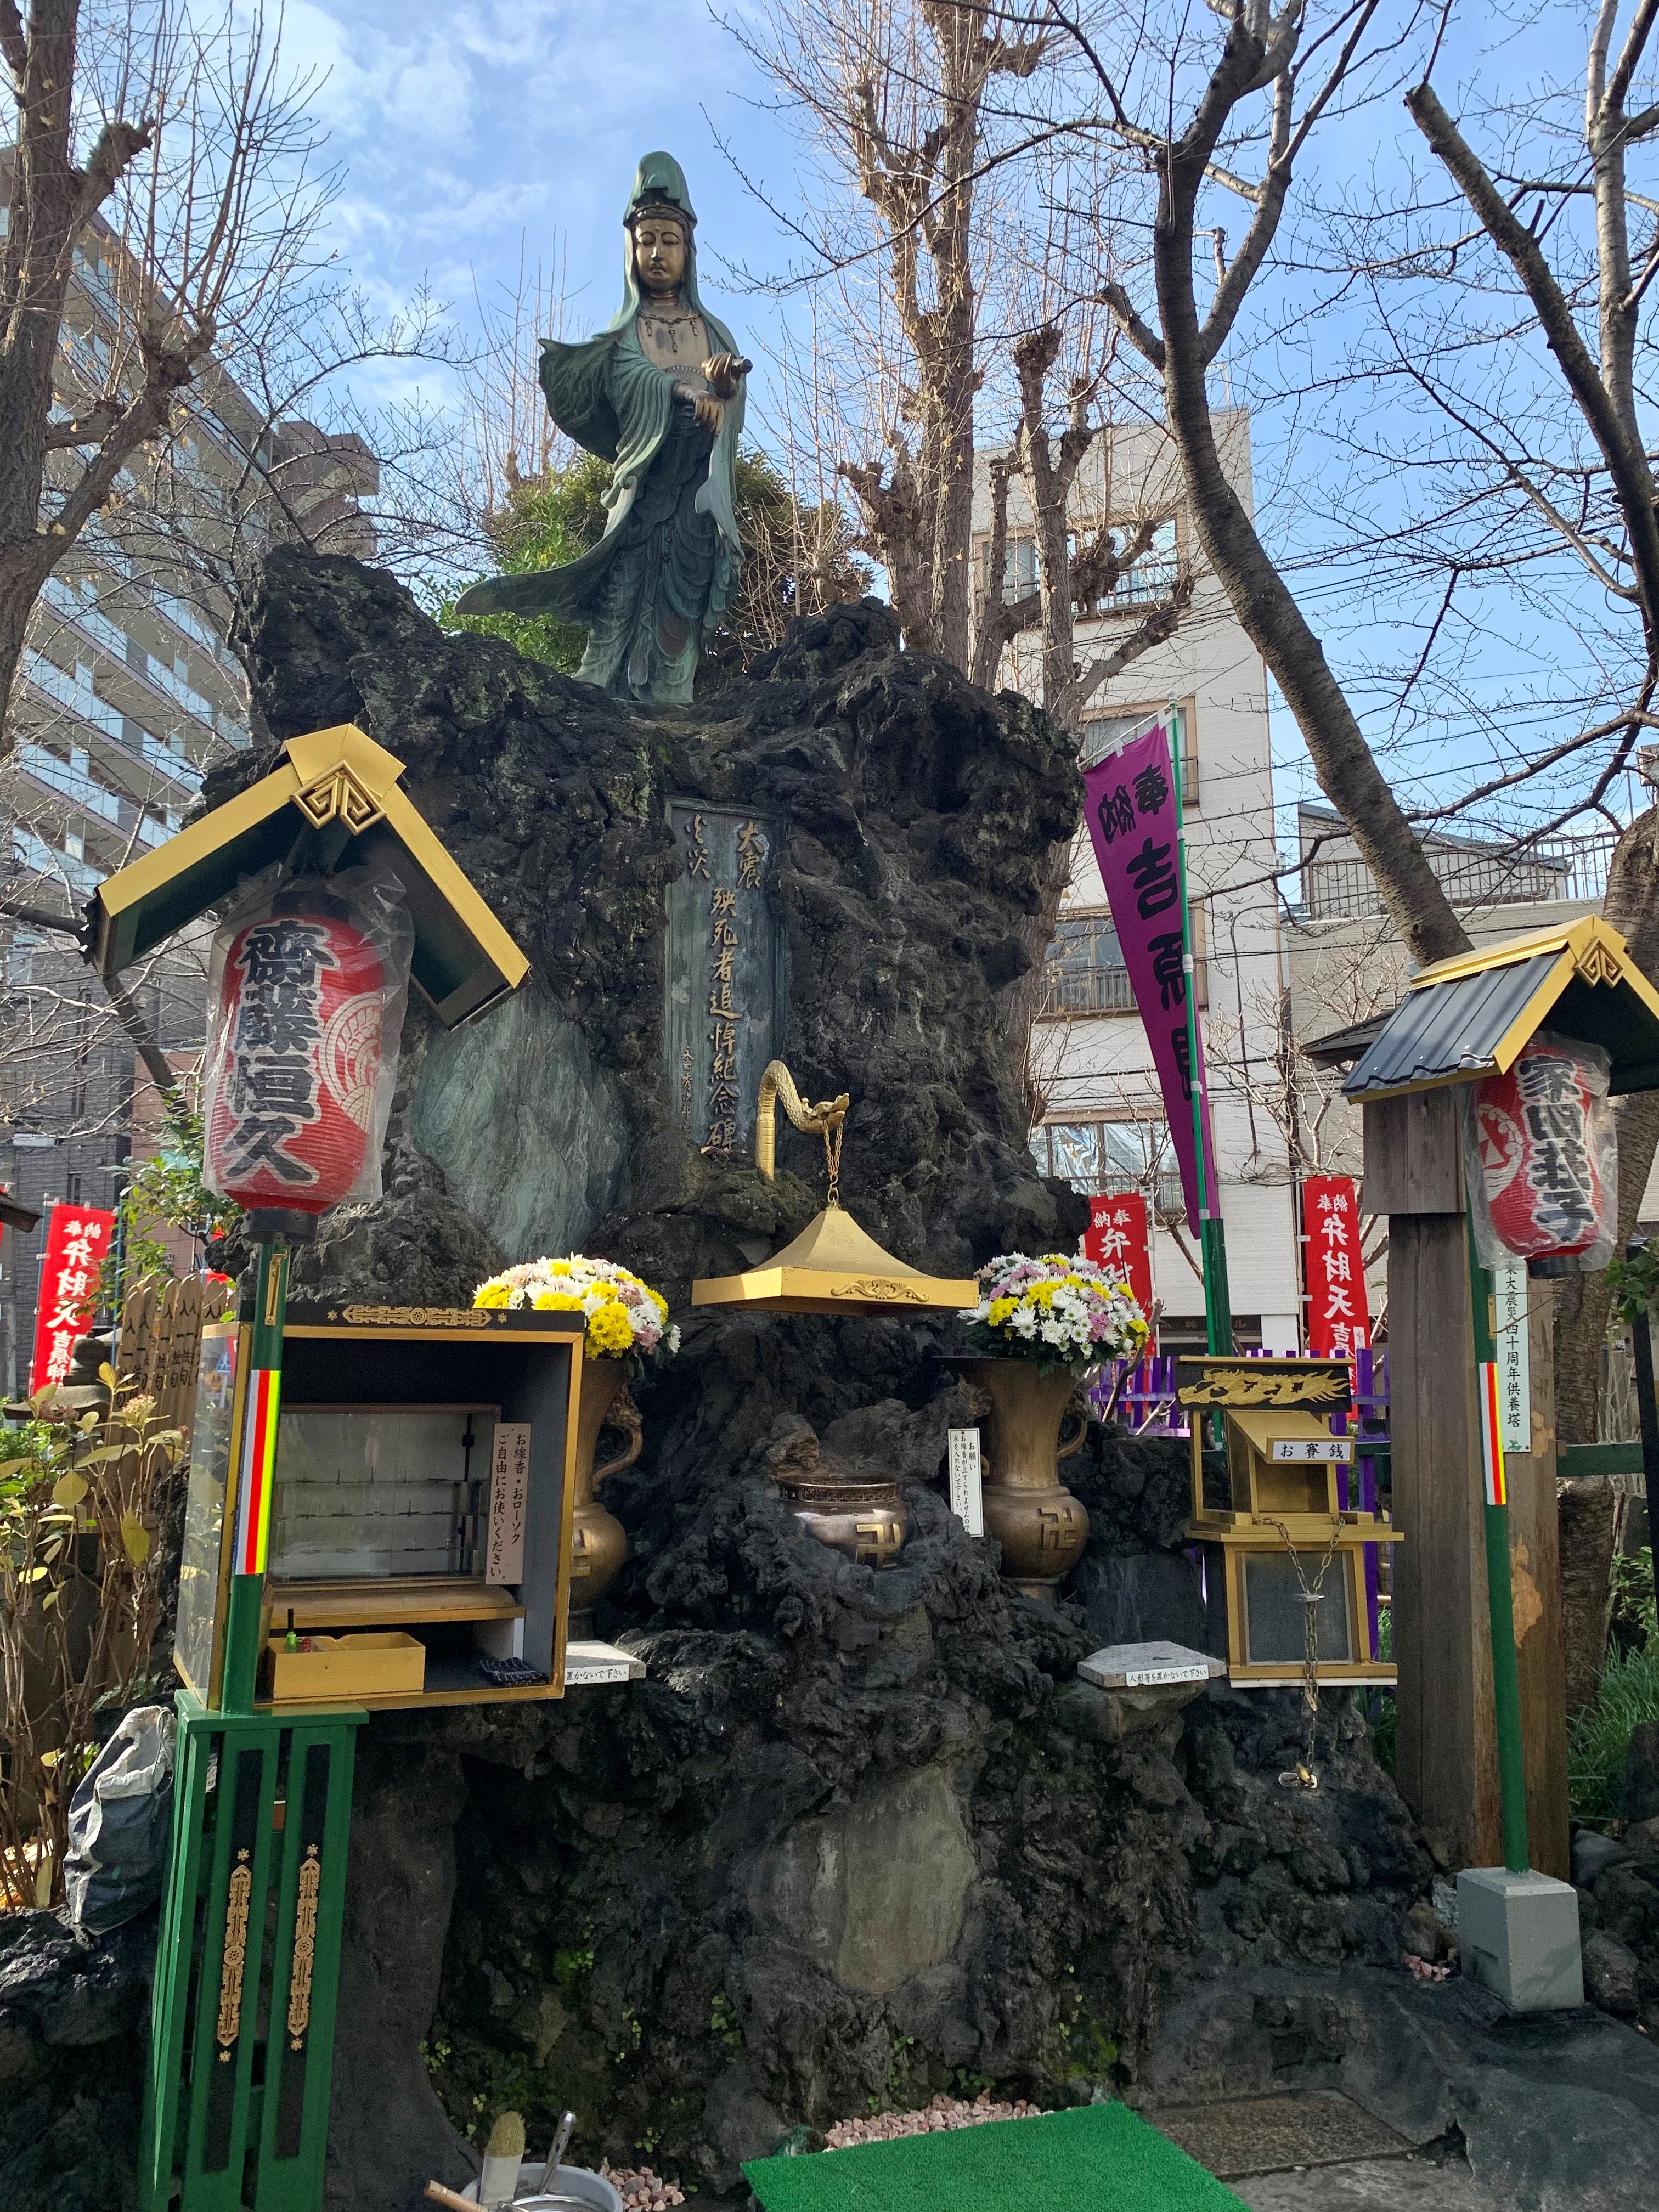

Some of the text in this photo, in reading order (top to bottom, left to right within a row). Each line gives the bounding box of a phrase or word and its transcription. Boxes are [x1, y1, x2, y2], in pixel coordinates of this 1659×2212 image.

[1093, 1209, 1132, 1229] 奉納
[1280, 1443, 1344, 1459] お賽銭
[511, 1434, 527, 1545] お線香・おローソク
[961, 1435, 970, 1531] お線香が立てられませんので
[1130, 1668, 1207, 1683] 人形等を置かないで下さい
